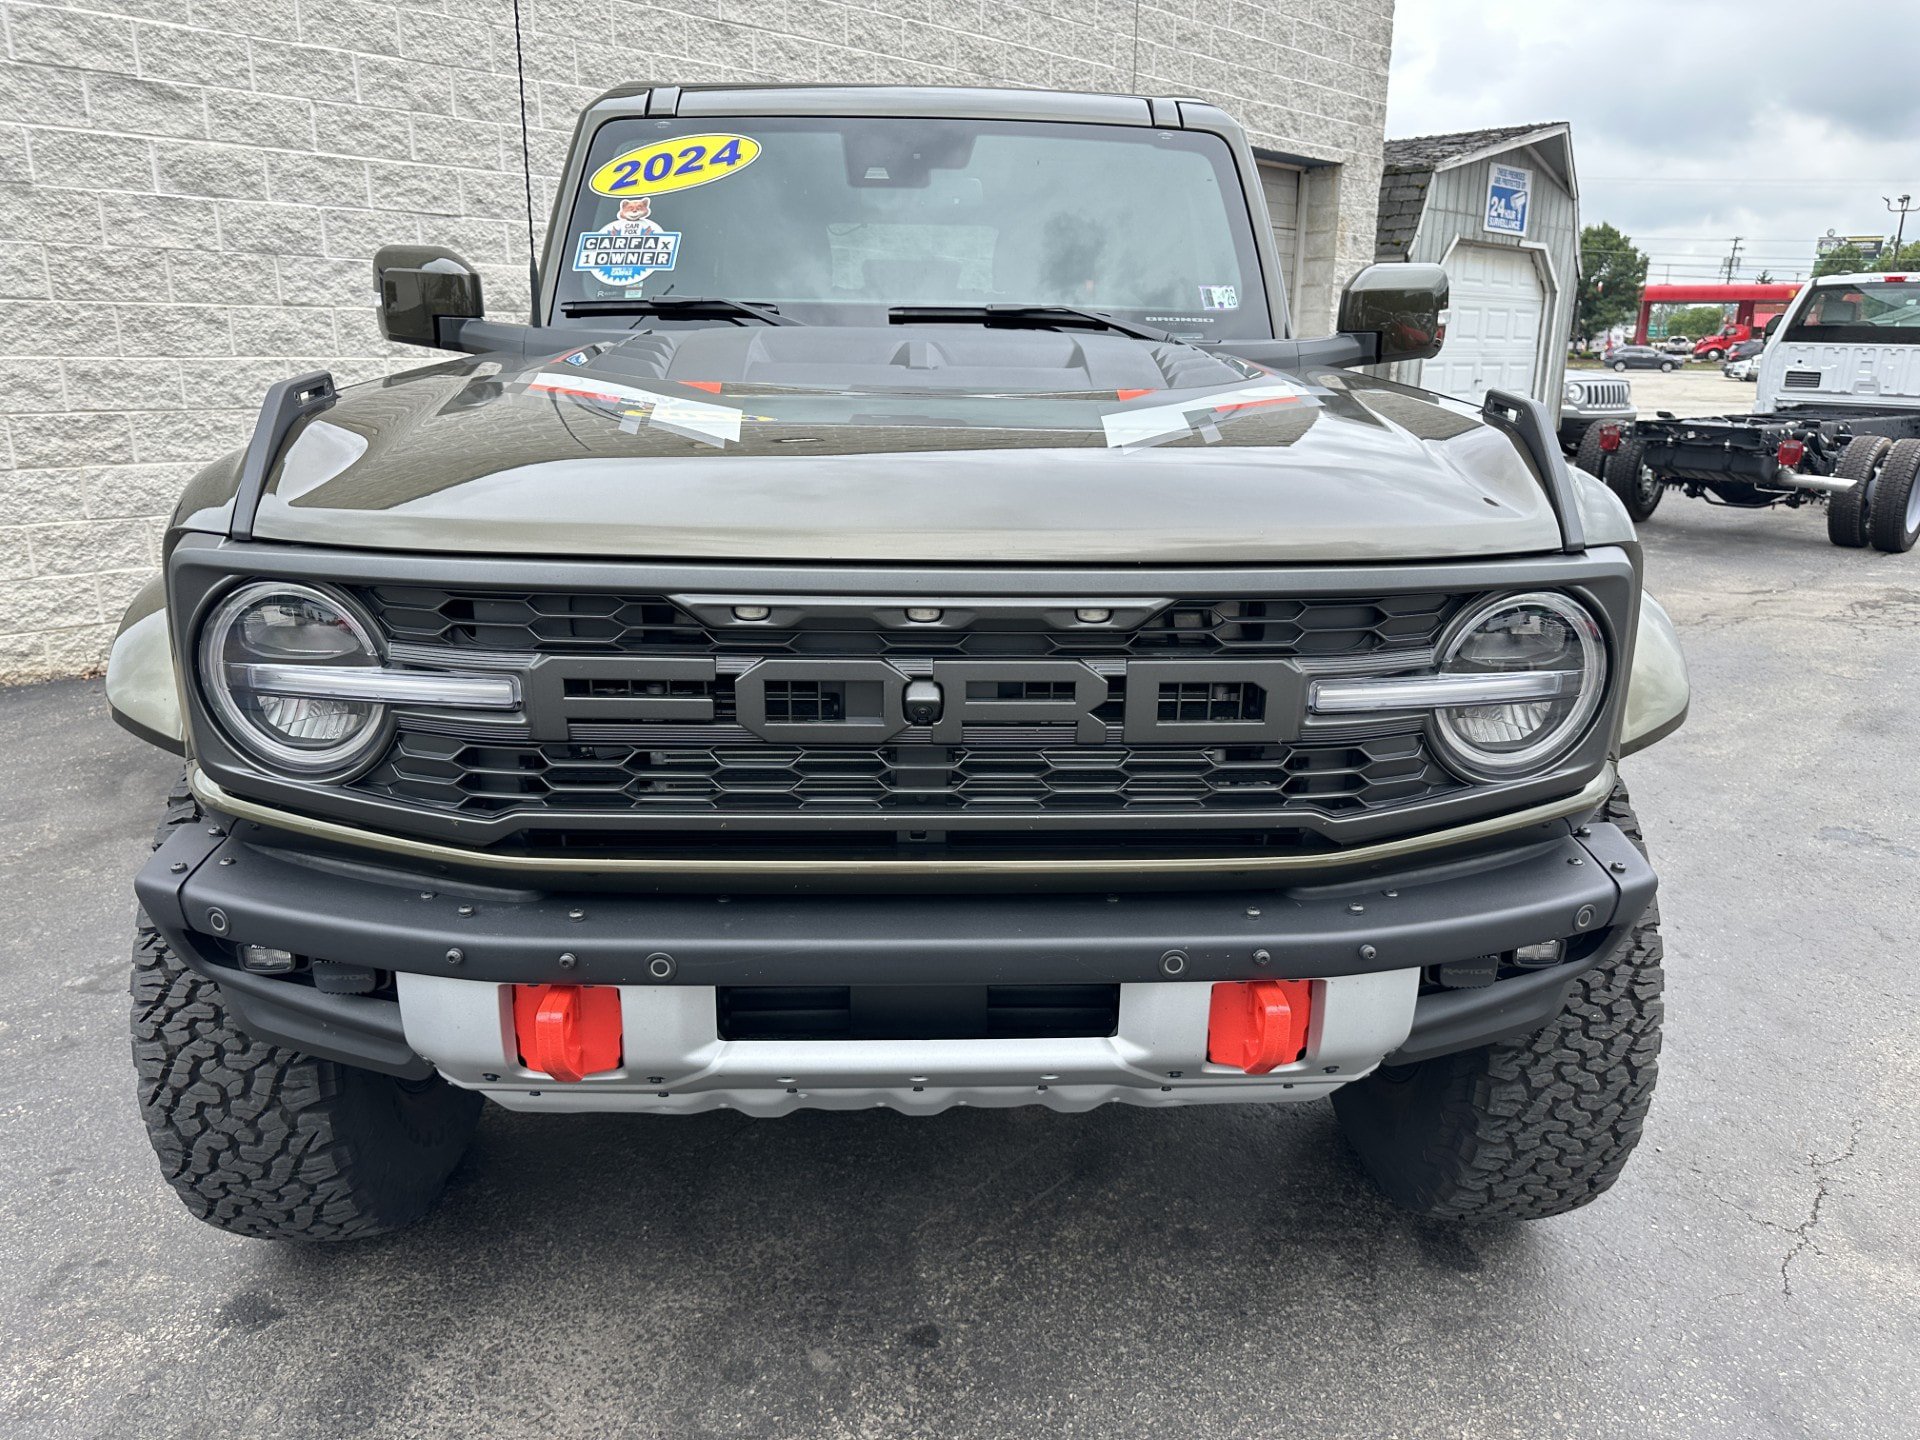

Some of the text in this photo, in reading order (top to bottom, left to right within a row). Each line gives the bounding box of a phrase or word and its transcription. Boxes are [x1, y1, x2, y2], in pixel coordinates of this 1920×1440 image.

[608, 138, 742, 192] 2024
[1490, 196, 1506, 217] 24
[583, 252, 671, 265] 1 OWNER
[530, 655, 1304, 745] FORD
